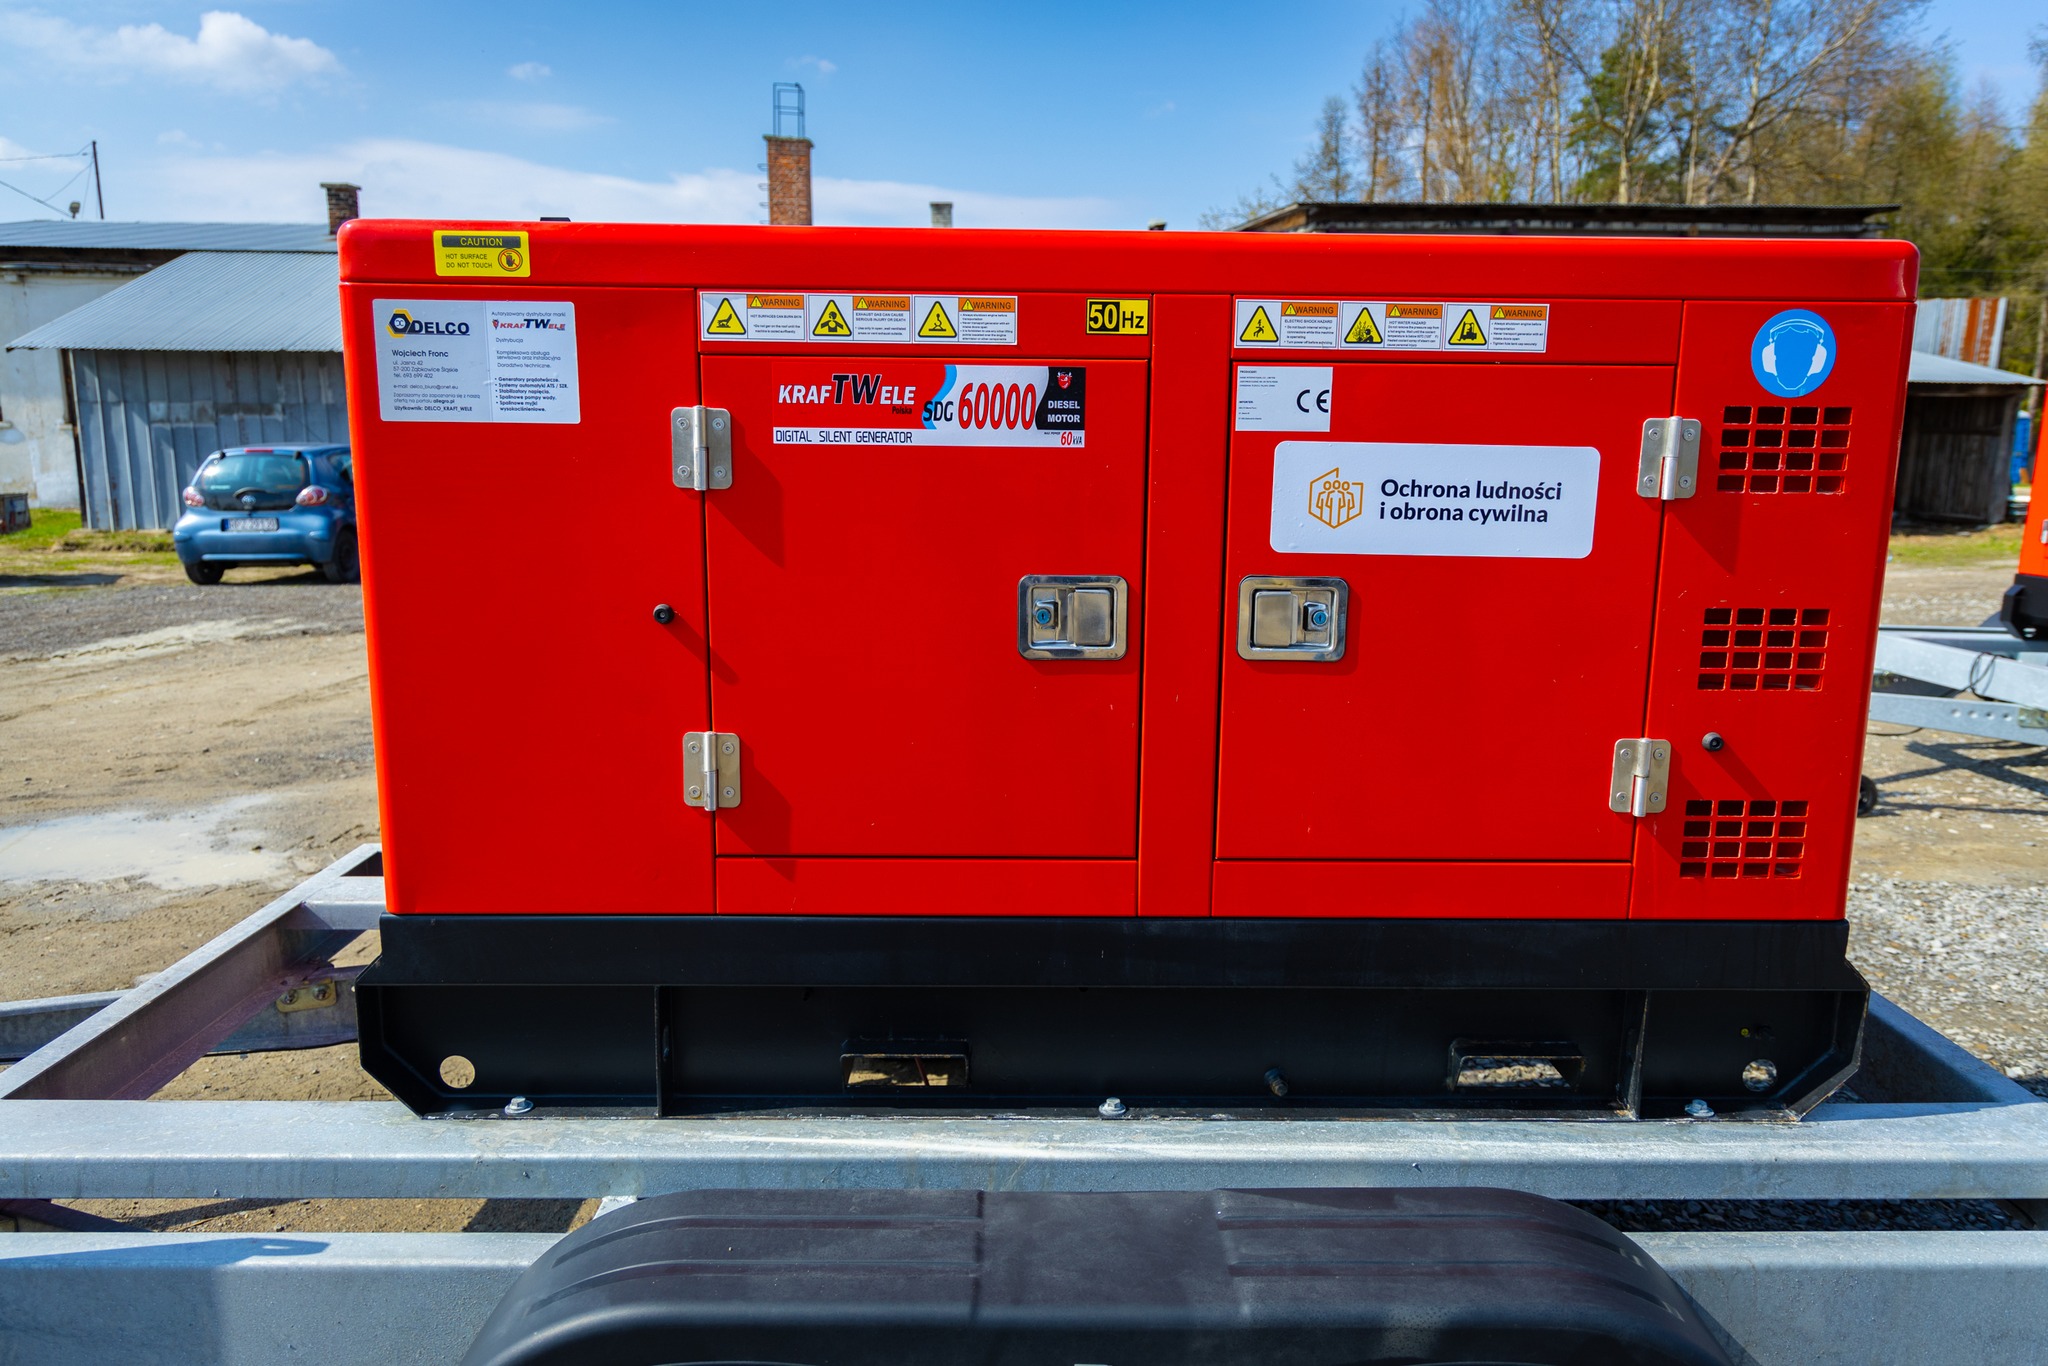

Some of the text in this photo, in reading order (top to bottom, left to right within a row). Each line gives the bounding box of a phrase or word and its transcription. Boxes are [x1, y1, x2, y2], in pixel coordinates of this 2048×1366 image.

[460, 237, 503, 247] CAUTION
[761, 298, 800, 307] WARNING
[867, 300, 906, 309] WARNING
[972, 301, 1011, 310] WARNING
[1295, 306, 1334, 314] WARNING
[1400, 307, 1439, 316] WARNING
[1504, 309, 1543, 318] WARNING
[413, 320, 470, 334] DELCO
[391, 349, 449, 358] Wojciech Fronc
[441, 366, 458, 374] Śląskie
[778, 373, 917, 406] KRAFTWELE
[922, 382, 1037, 430] SDG 60000
[1047, 400, 1081, 410] DIESEL
[1297, 389, 1330, 413] CE
[891, 405, 913, 415] Polska
[1047, 414, 1081, 423] MOTOR
[775, 429, 913, 444] DIGITAL SILENT GENERATOR
[1380, 478, 1562, 501] Ochrona ludności
[1379, 501, 1548, 526] i obrona cywilna
